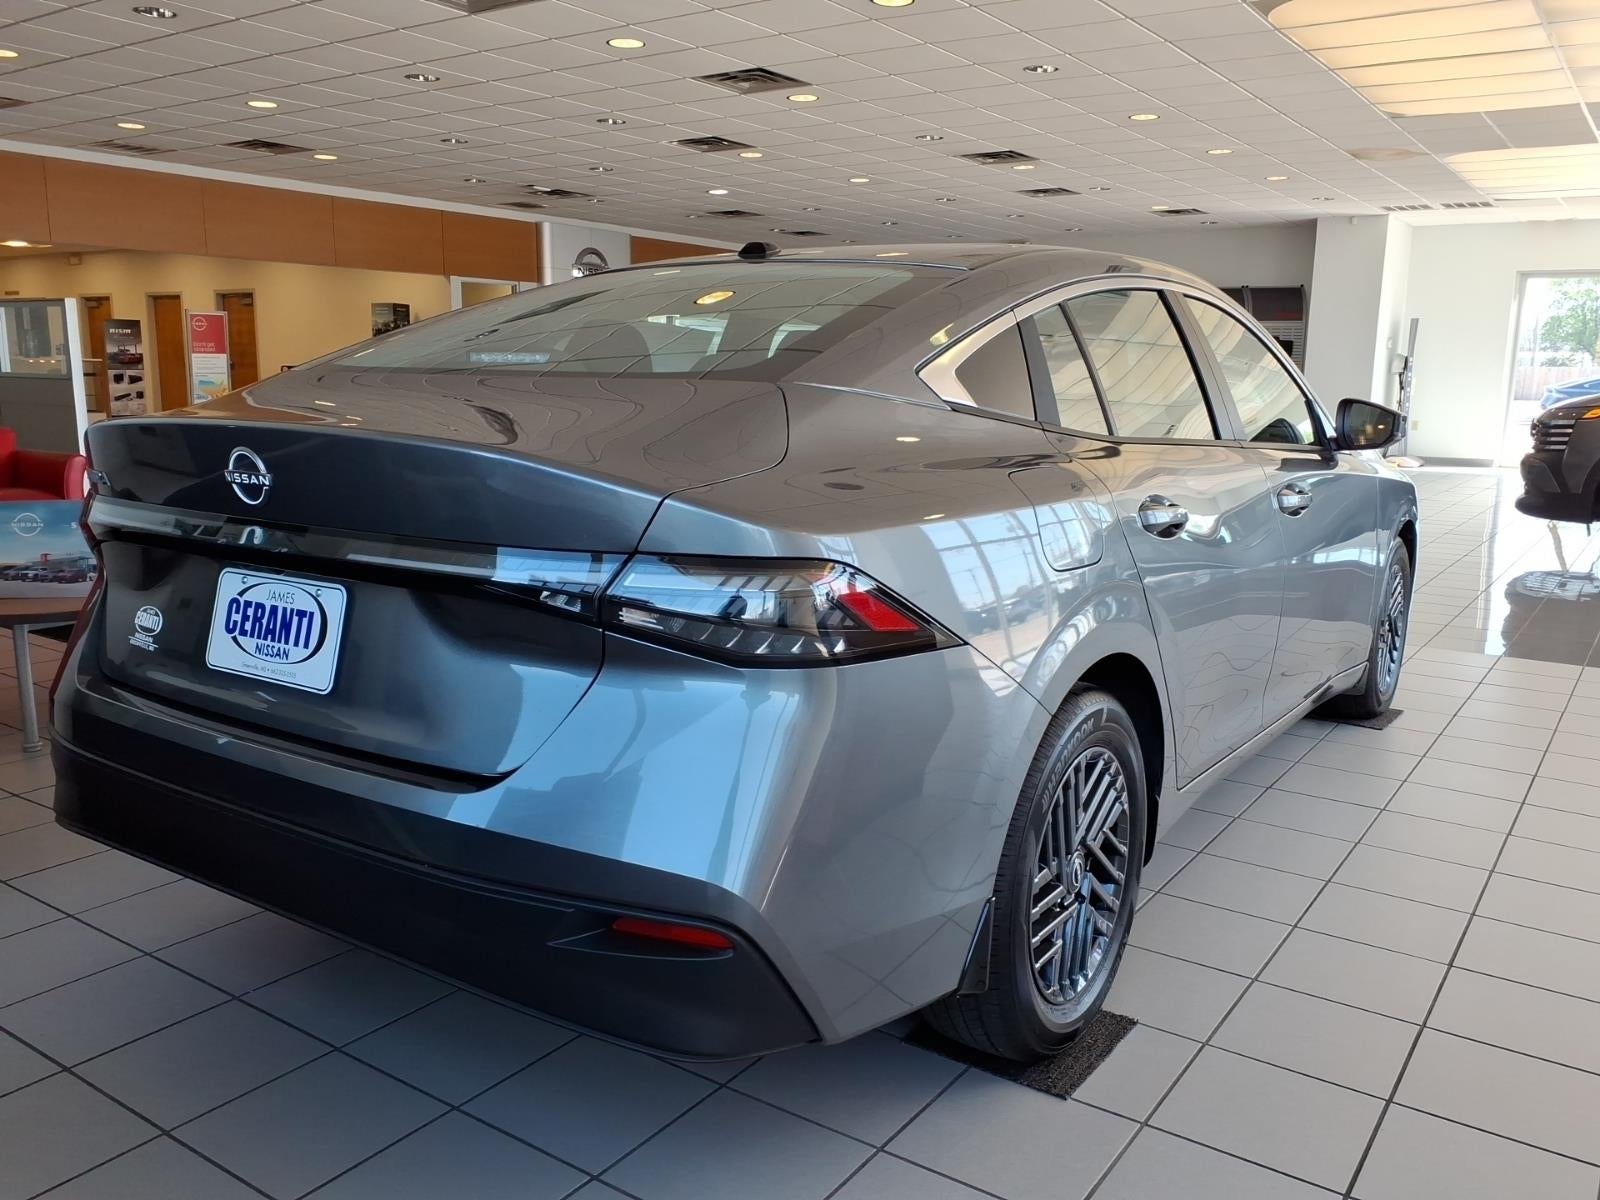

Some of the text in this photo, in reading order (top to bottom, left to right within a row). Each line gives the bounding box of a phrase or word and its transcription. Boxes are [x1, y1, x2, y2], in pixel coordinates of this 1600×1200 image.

[225, 471, 270, 486] NISSAN
[266, 589, 295, 605] JAMES
[224, 596, 315, 650] CERANTI
[255, 641, 290, 661] NISSAN
